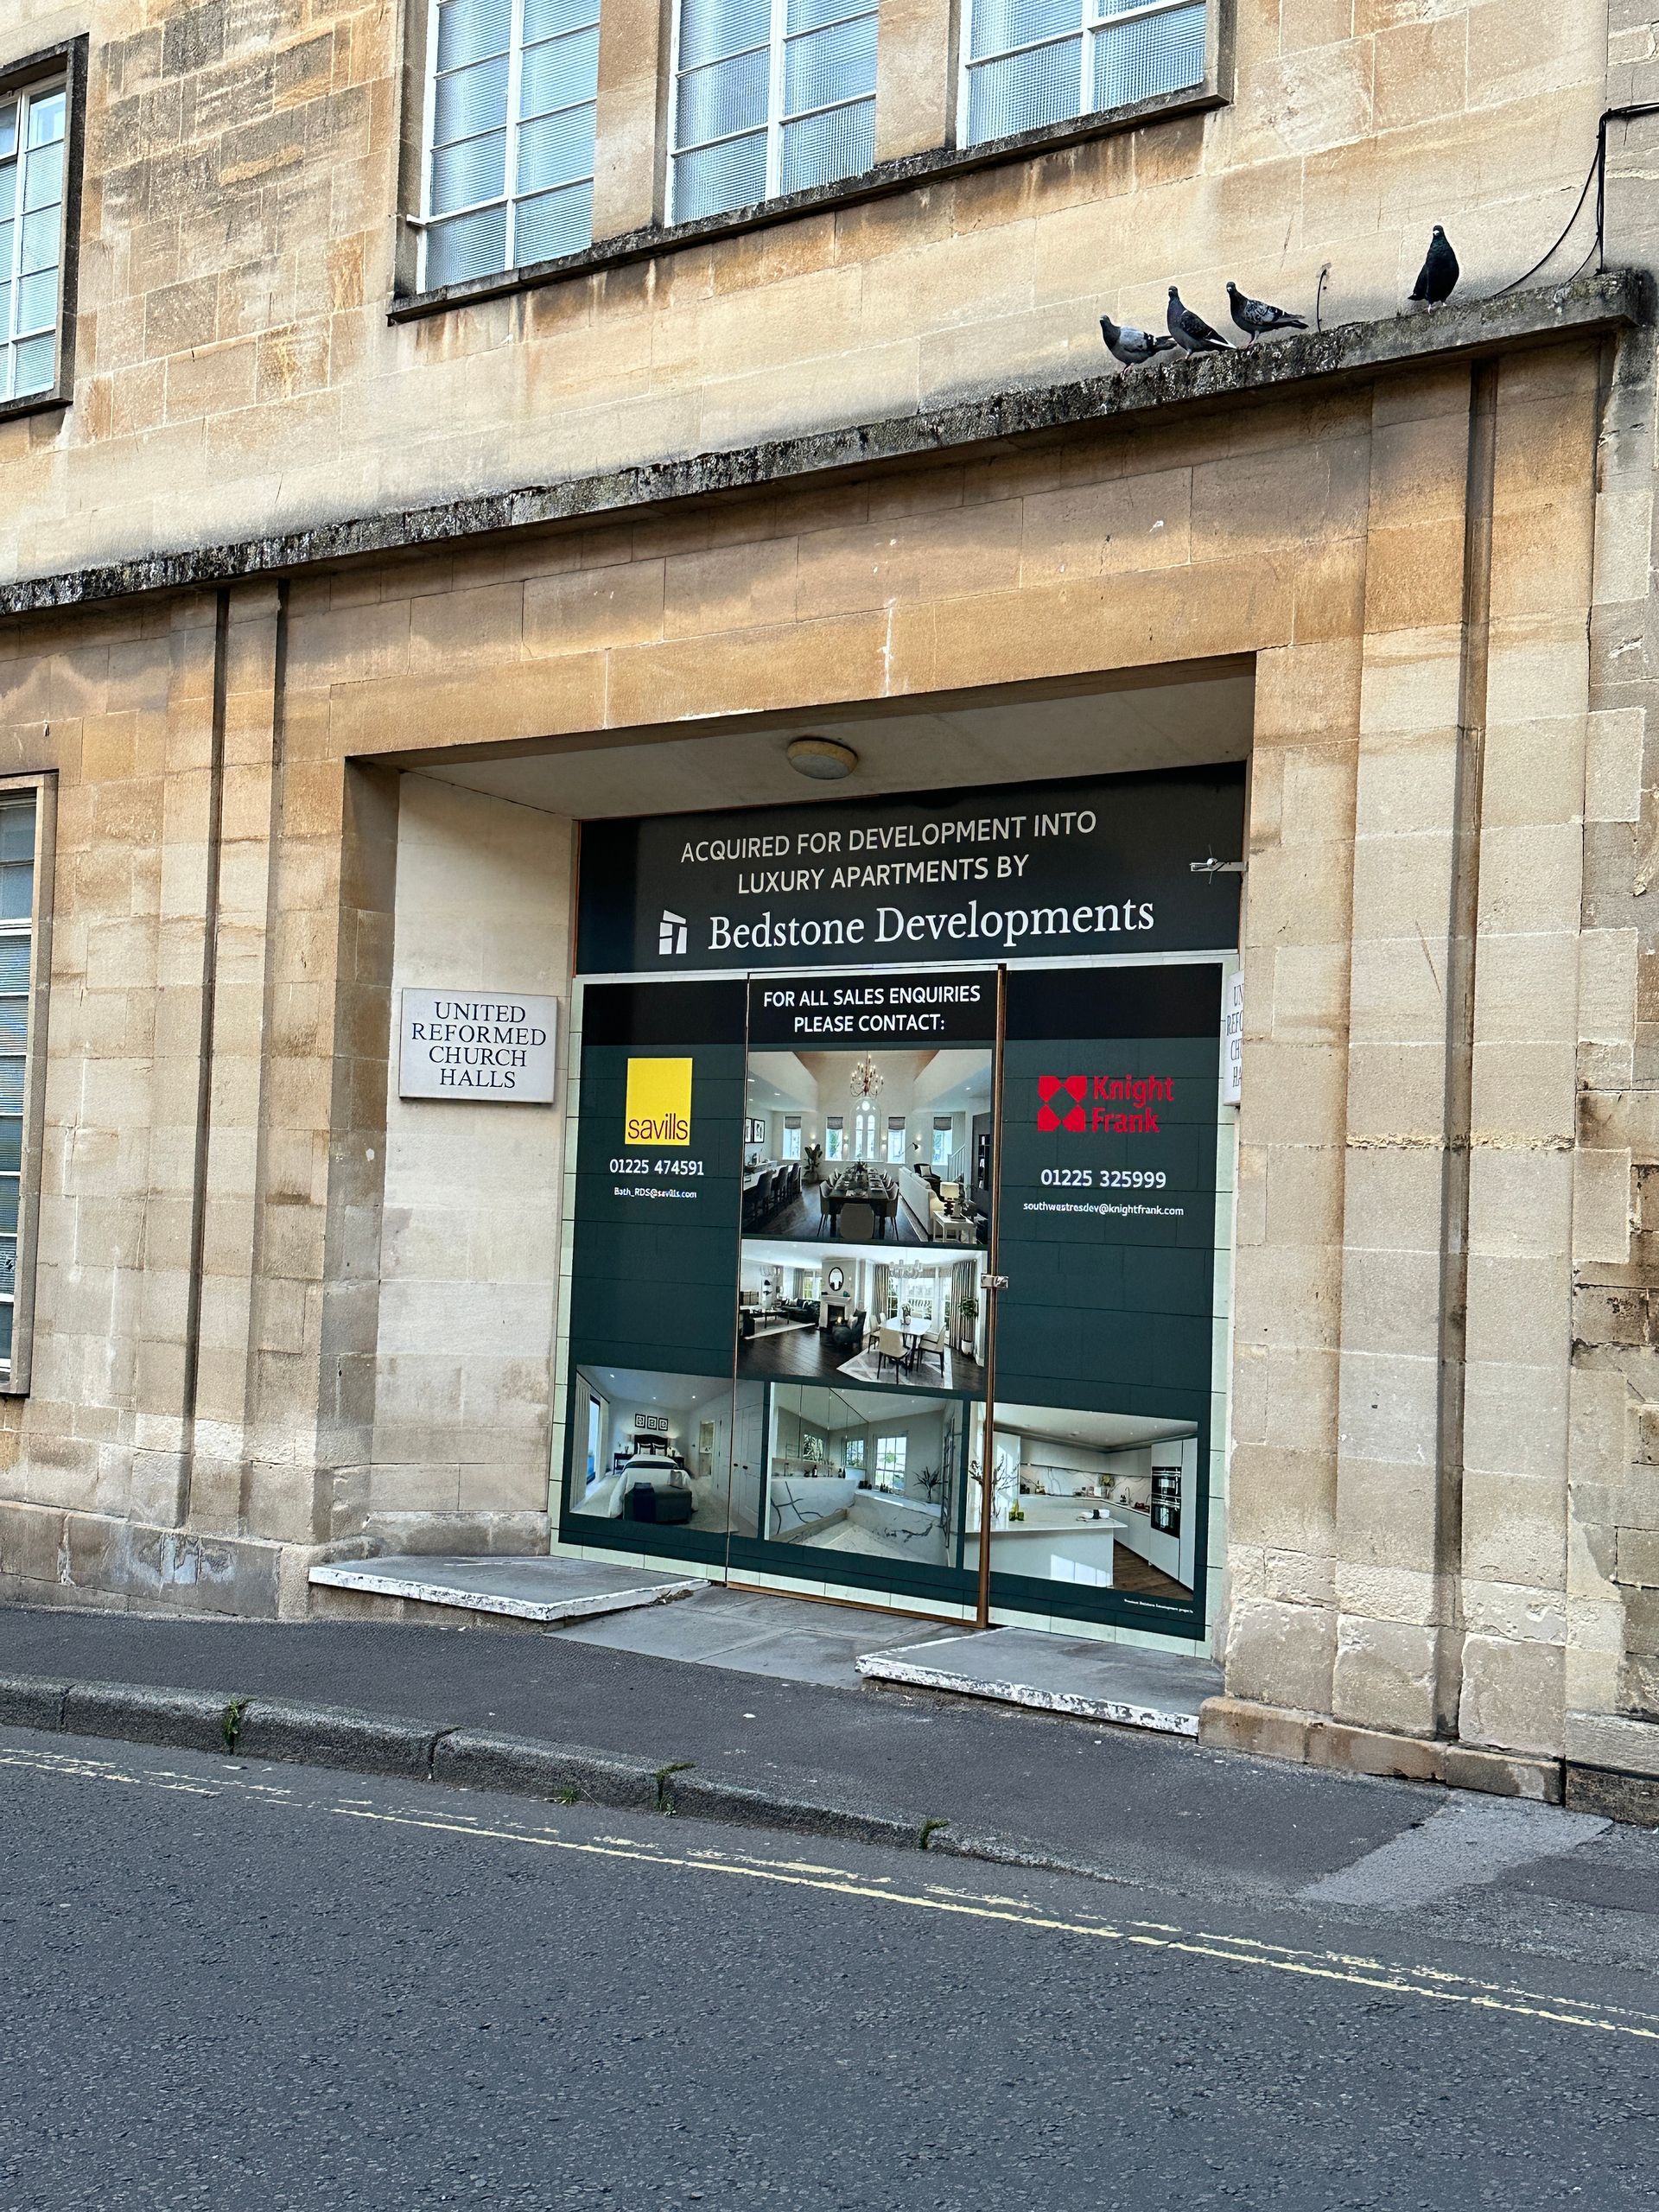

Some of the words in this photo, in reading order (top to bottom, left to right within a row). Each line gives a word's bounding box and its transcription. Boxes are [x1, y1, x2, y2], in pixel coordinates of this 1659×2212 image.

[681, 836, 790, 862] ACQUIRED
[798, 831, 842, 855] FOR
[849, 816, 1027, 851] DEVELOPMENT
[1033, 810, 1096, 837] INTO
[738, 868, 825, 894] LUXURY
[830, 857, 988, 889] APARTMENTS
[996, 854, 1030, 878] BY
[708, 912, 865, 950] Bedstone
[874, 899, 1154, 947] Developments
[763, 991, 795, 1007] FOR
[799, 990, 829, 1007] ALL
[833, 988, 885, 1006] SALES
[889, 985, 981, 1005] ENQUIRIES
[435, 1001, 526, 1023] UNITED
[411, 1023, 547, 1046] REFORMED
[794, 1015, 855, 1033] PLEASE
[858, 1014, 945, 1033] CONTACT:
[429, 1046, 527, 1067] CHURCH
[439, 1068, 516, 1089] HALLS
[1092, 1074, 1175, 1108] Knight
[627, 1113, 689, 1141] savills
[1091, 1107, 1160, 1134] Frank
[609, 1159, 650, 1174] 01225
[654, 1160, 704, 1176] 474591
[1040, 1169, 1093, 1186] 01225
[1099, 1170, 1167, 1189] 325999
[1023, 1201, 1185, 1216] southwestresdev@knightfrank.com
